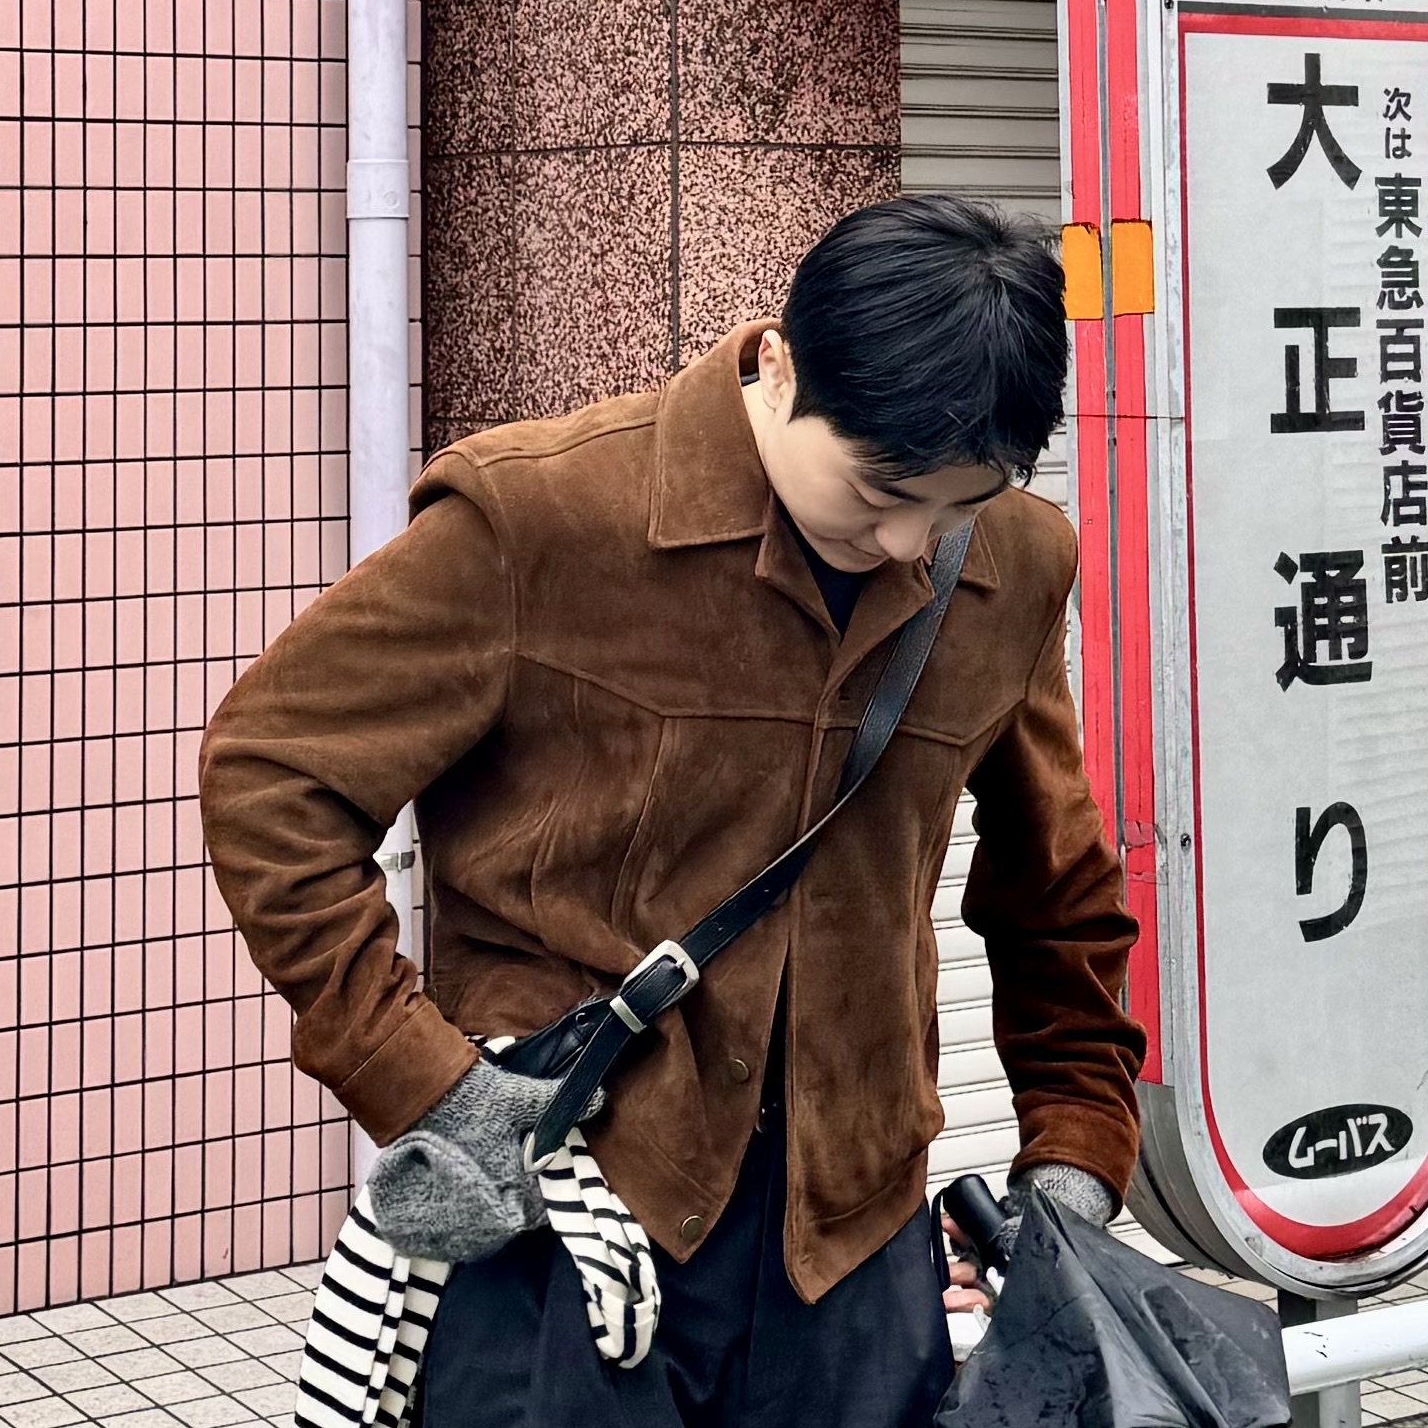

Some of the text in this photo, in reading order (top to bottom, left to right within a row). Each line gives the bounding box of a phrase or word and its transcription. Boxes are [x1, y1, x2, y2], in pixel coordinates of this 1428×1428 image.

[1266, 52, 1374, 943] 大正通り
[1287, 1113, 1396, 1169] ムーバス
